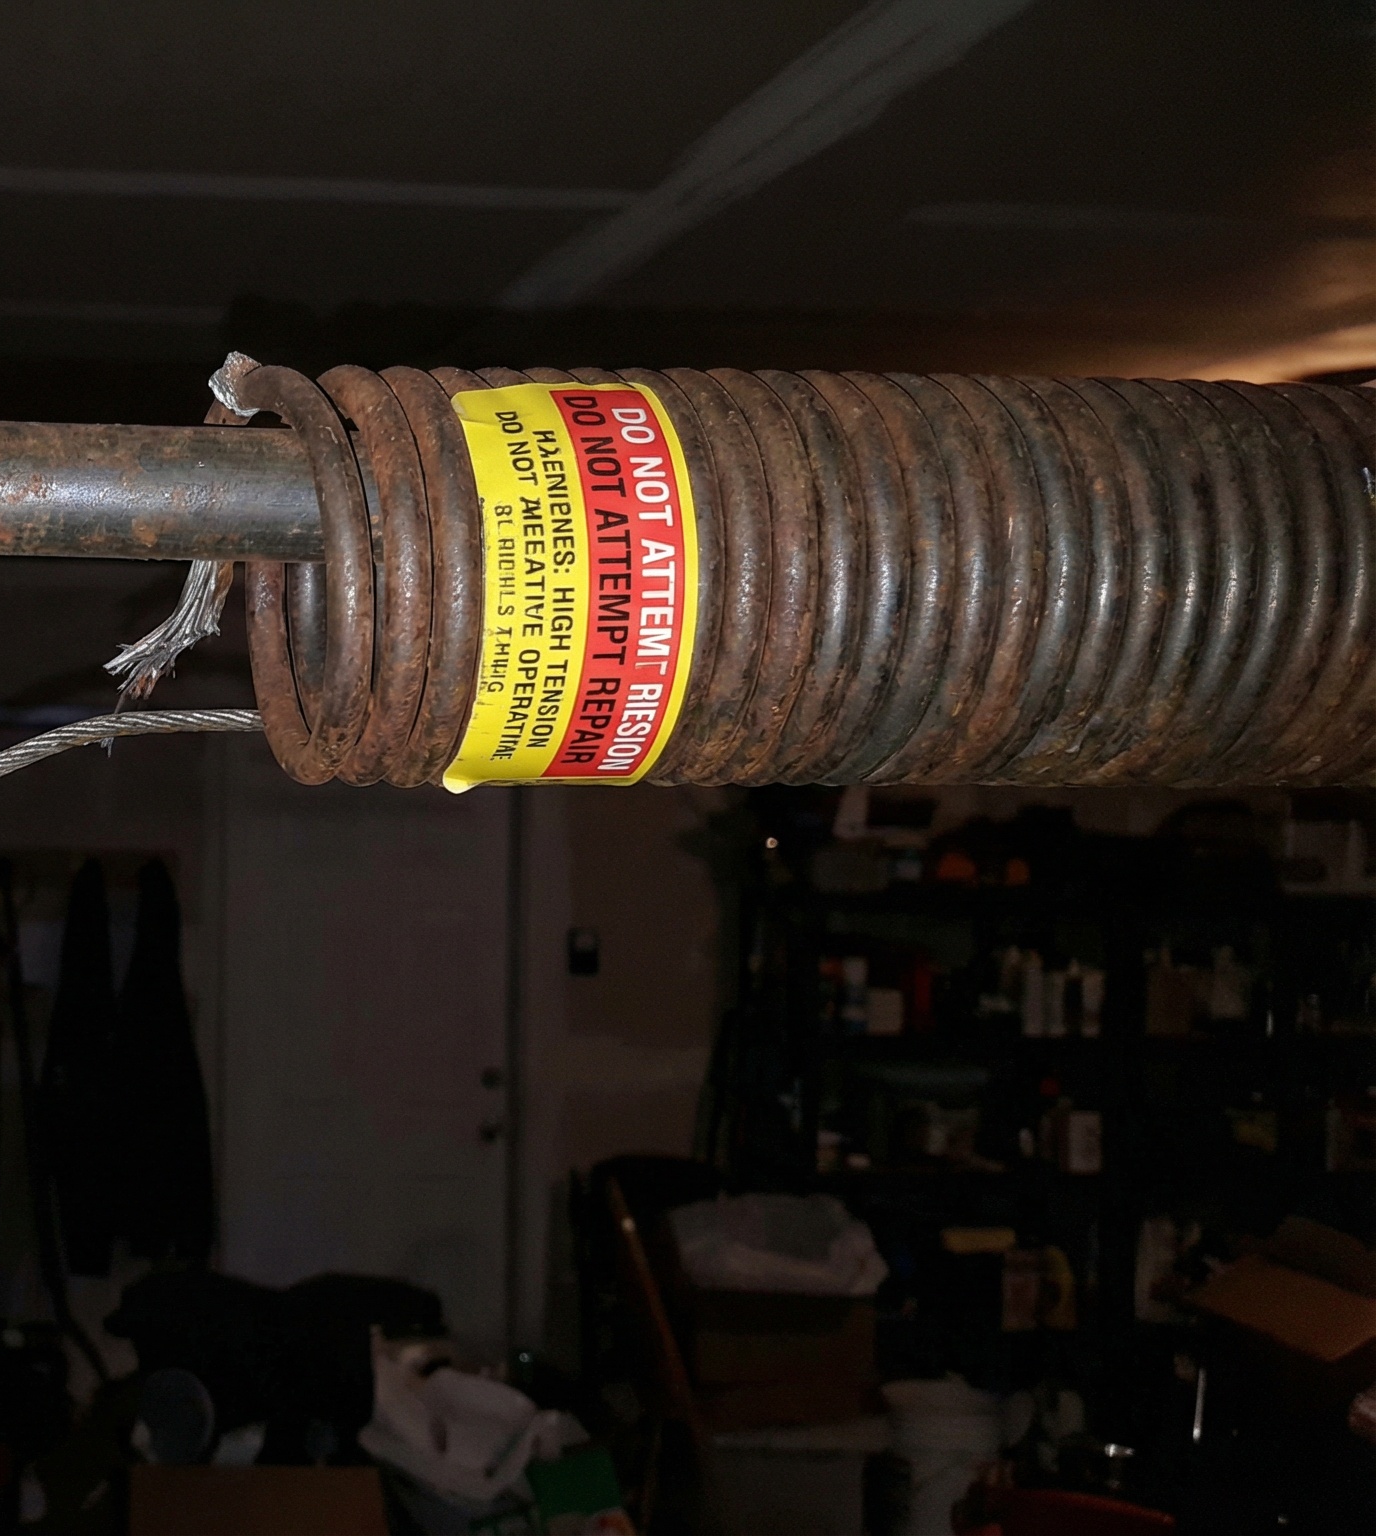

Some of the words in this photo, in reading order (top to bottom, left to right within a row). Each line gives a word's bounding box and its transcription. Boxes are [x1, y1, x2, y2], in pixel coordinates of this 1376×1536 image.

[496, 411, 530, 434] DO
[564, 396, 607, 426] DO
[611, 408, 654, 444] DO
[507, 441, 537, 486] NOT
[581, 437, 626, 498] NOT
[629, 457, 673, 527] NOT
[592, 509, 631, 666] ATTEMPT
[549, 588, 574, 651] HIGH
[527, 660, 568, 748] TENSION
[561, 678, 620, 764] REPAIR
